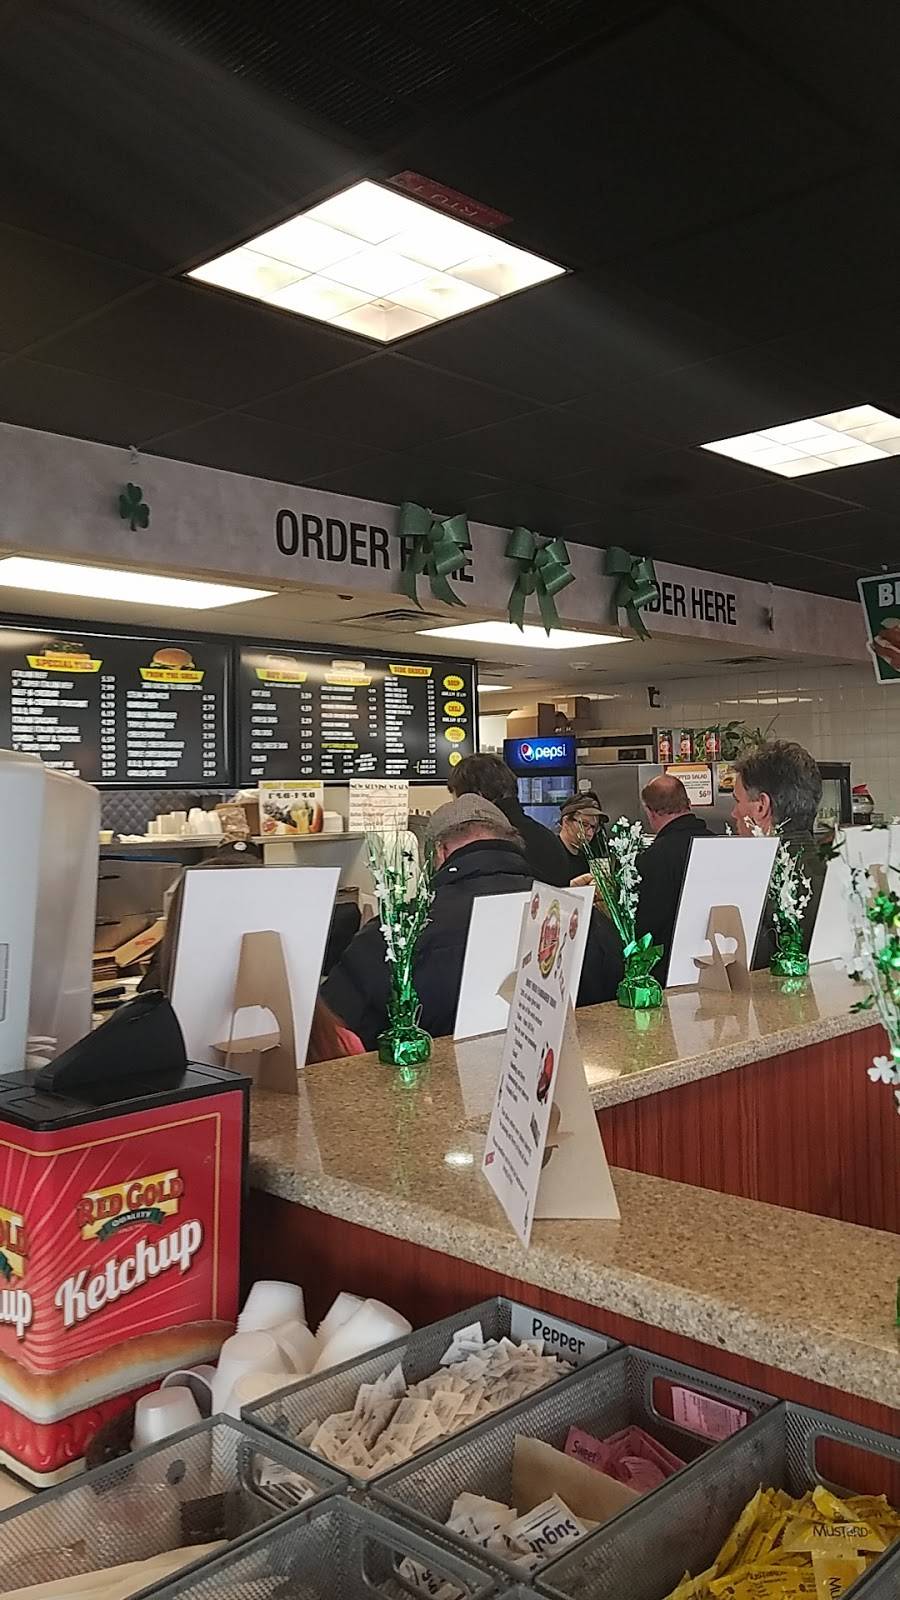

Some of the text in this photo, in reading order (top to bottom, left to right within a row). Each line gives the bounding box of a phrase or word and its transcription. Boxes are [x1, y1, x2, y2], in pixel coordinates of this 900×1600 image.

[275, 509, 391, 570] ORDER
[691, 586, 737, 626] HERE
[535, 744, 566, 760] pepsi
[78, 1177, 184, 1228] RED GOLD
[54, 1219, 203, 1329] Ketchup
[532, 1318, 585, 1355] Pepper
